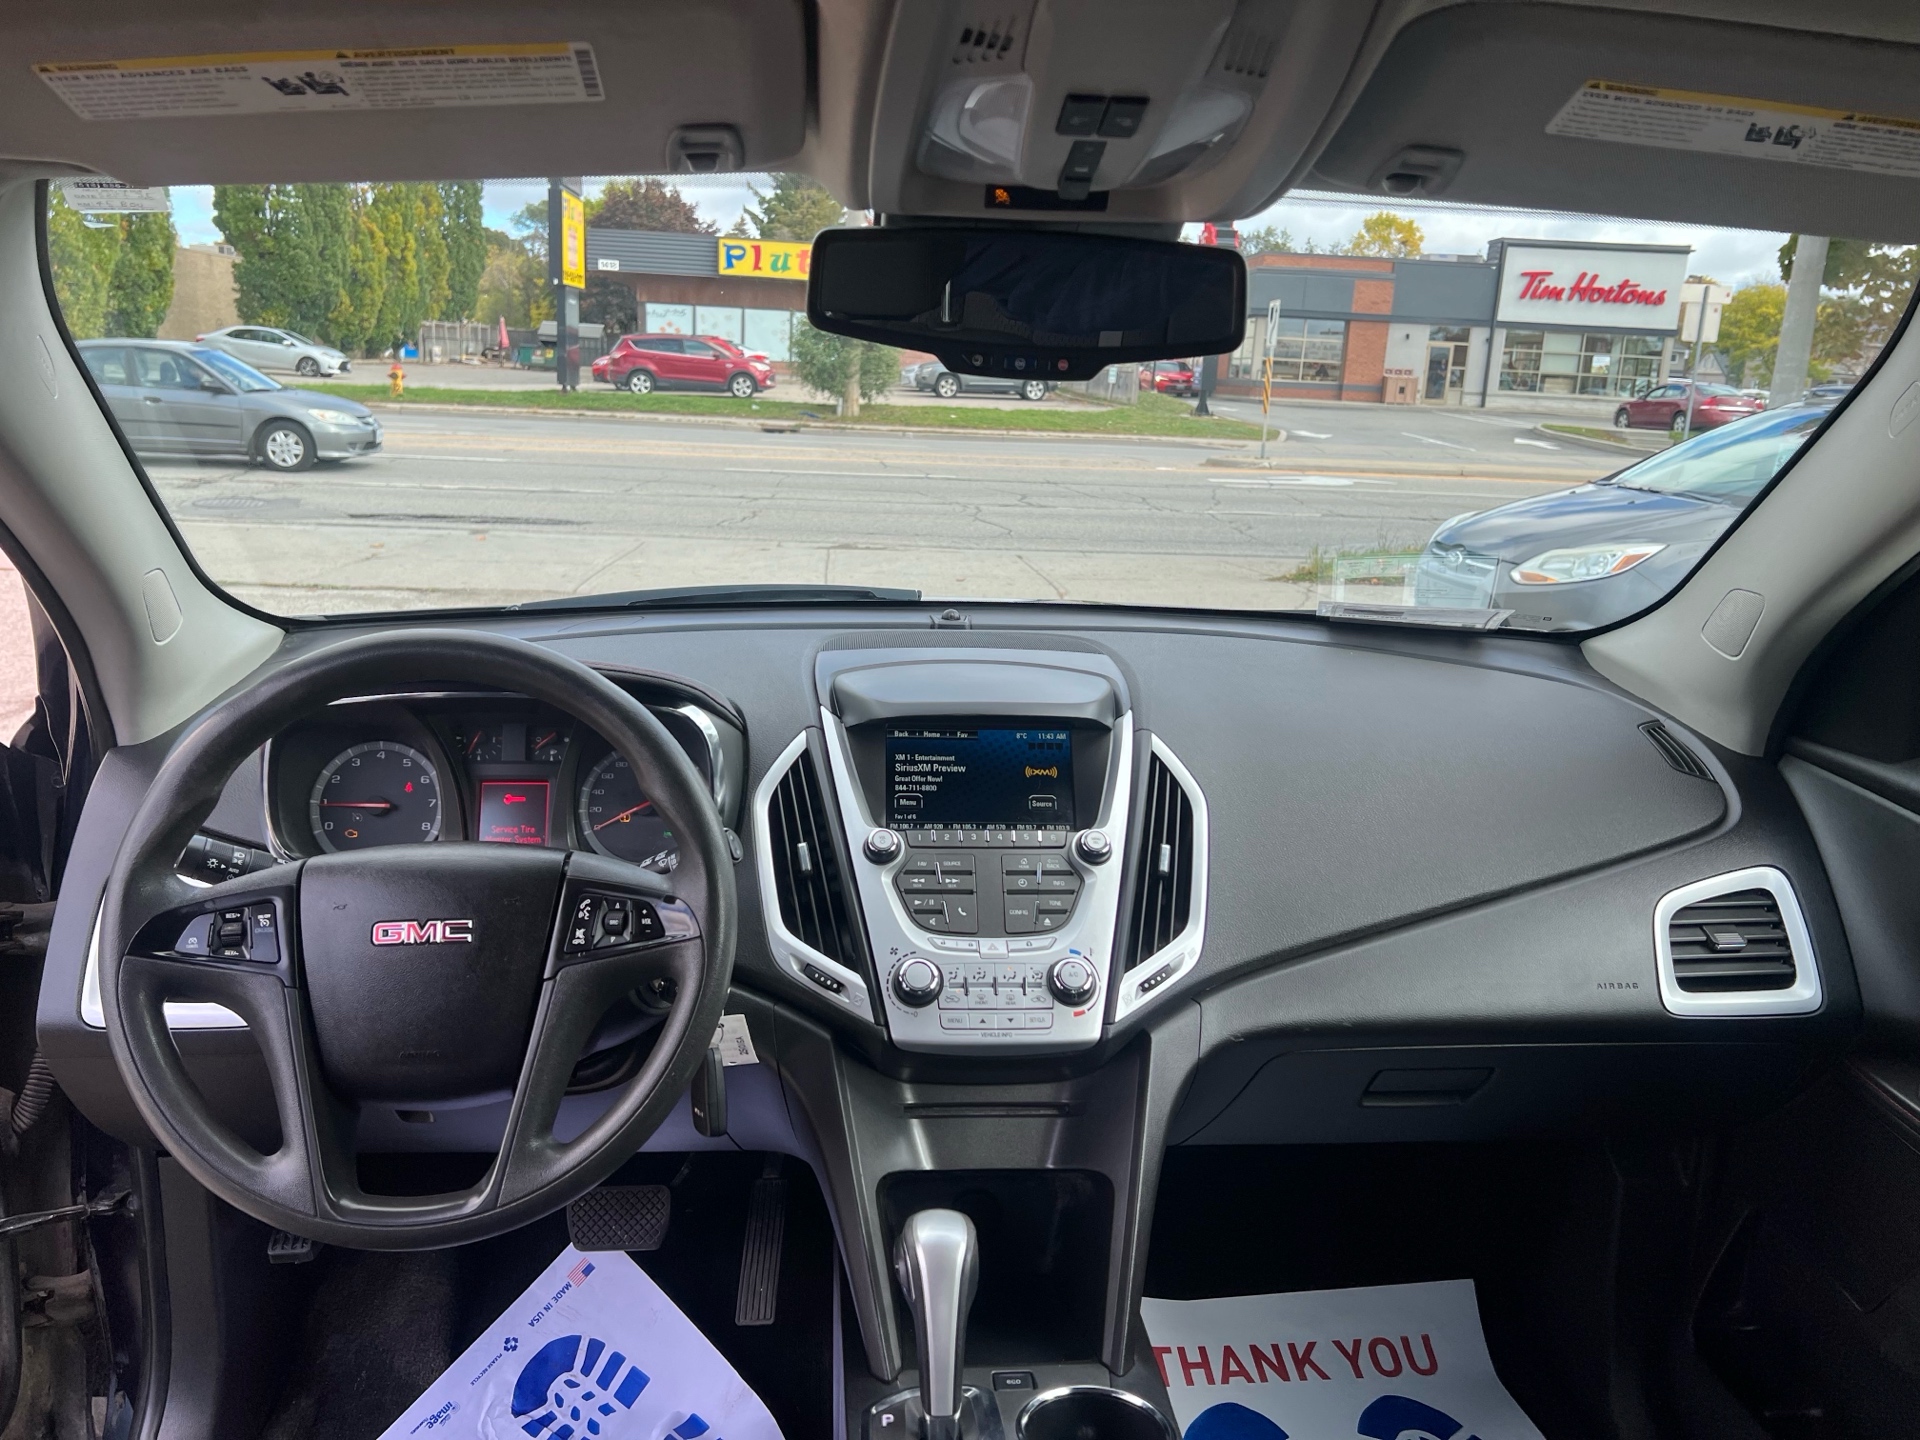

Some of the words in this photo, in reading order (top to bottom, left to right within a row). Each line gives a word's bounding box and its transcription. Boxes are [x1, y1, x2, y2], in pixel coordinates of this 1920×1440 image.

[1520, 271, 1563, 301] Tim
[1567, 271, 1668, 306] Hortons
[376, 751, 386, 759] 4
[915, 754, 956, 762] Entertainment
[351, 758, 360, 767] 3
[402, 759, 411, 767] 5
[895, 763, 931, 772] SiriusXM
[932, 763, 966, 773] Preview
[331, 775, 341, 783] 2
[420, 775, 430, 783] 6
[927, 775, 943, 783] Now!
[428, 799, 436, 807] 7
[324, 822, 333, 830] 0
[421, 822, 431, 831] 8
[491, 825, 518, 834] Service
[520, 825, 535, 834] Tire
[514, 835, 542, 844] System
[372, 919, 473, 945] GMC
[1596, 982, 1639, 990] AIRBAG
[551, 1281, 573, 1304] MADE
[543, 1302, 553, 1312] IN
[527, 1311, 545, 1328] USA
[487, 1352, 503, 1369] PLEASE
[1151, 1341, 1332, 1388] THANK
[1331, 1333, 1439, 1379] YOU
[470, 1367, 488, 1386] RECYCLE
[425, 1401, 455, 1429] image
[882, 1414, 894, 1427] P
